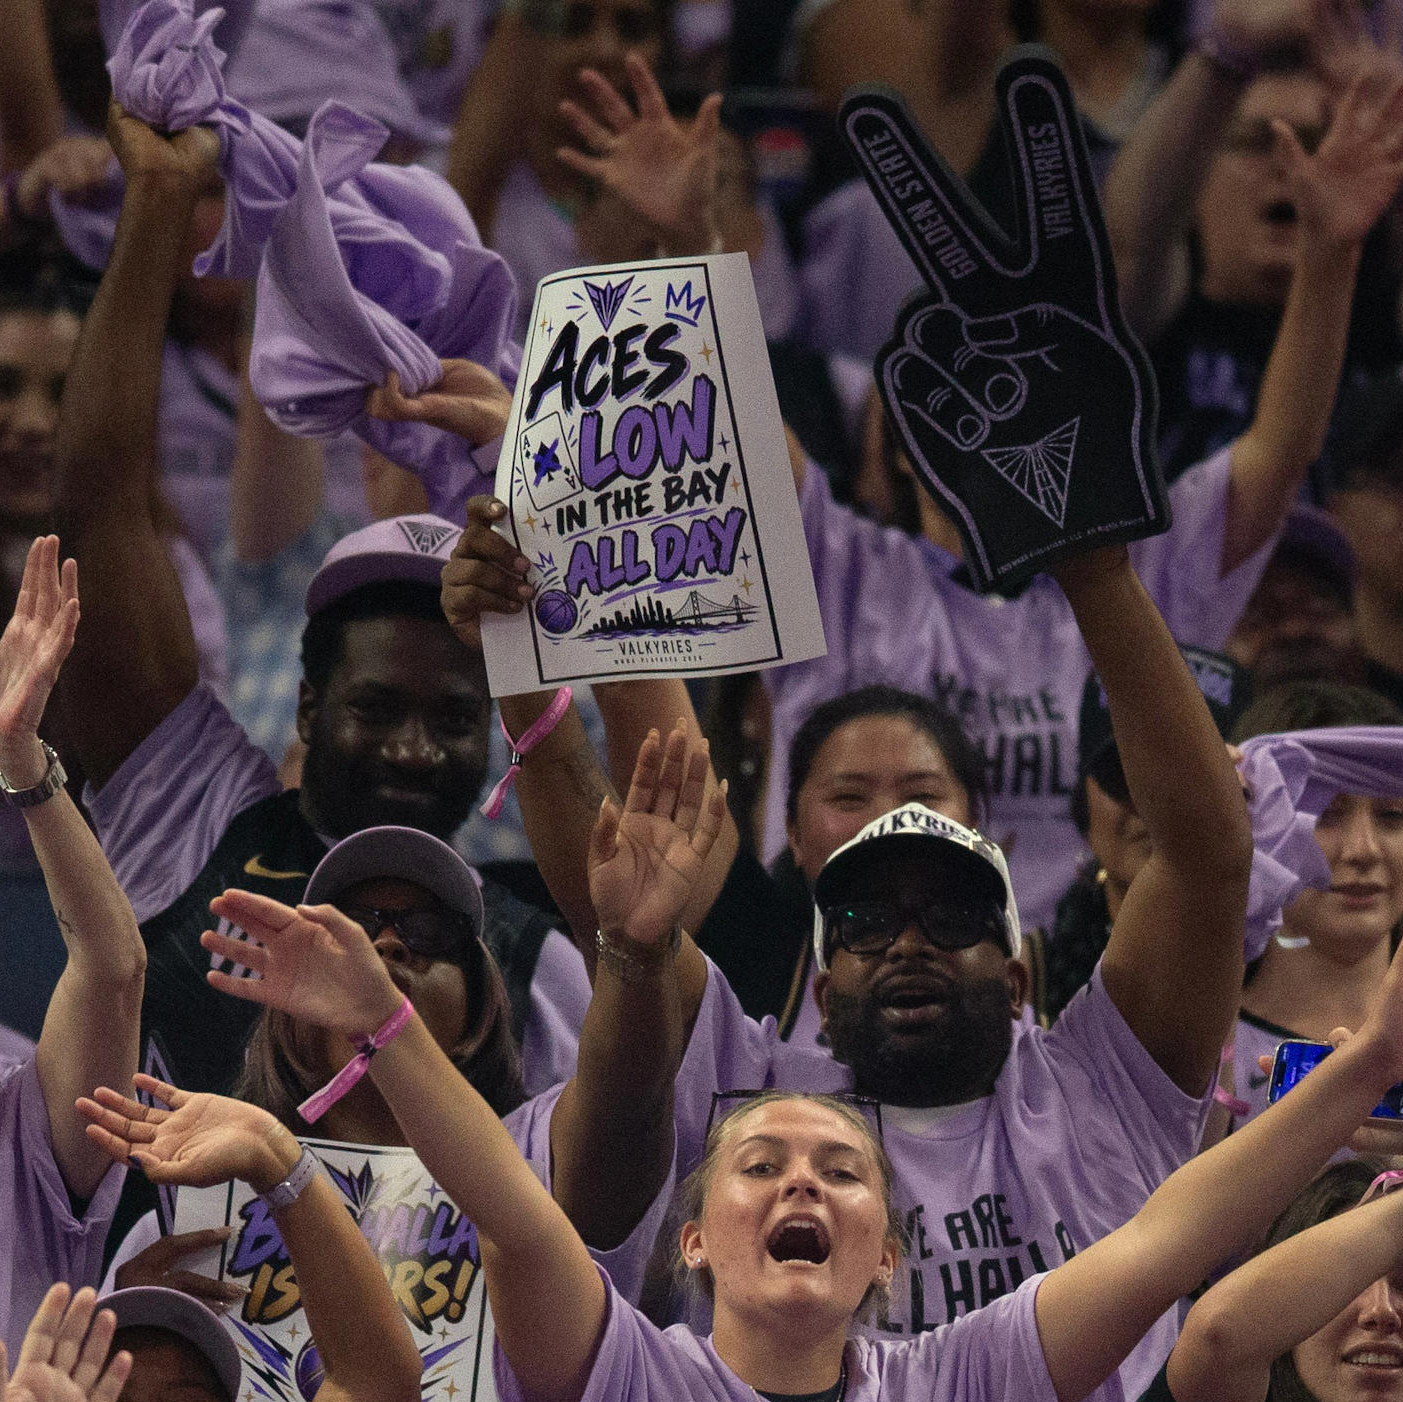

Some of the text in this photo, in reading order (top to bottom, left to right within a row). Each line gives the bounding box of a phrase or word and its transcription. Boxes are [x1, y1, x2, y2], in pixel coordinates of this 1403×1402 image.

[861, 129, 979, 280] GOLDEN STATE
[1026, 122, 1074, 240] VALKYRIES
[526, 321, 689, 422] ACES
[578, 374, 717, 492] LOW
[556, 462, 732, 536] IN THE BAY
[564, 506, 747, 600] ALL DAY
[618, 638, 693, 656] VALKYRIES
[944, 1193, 1023, 1251] ARE
[242, 1257, 481, 1335] IS RS!
